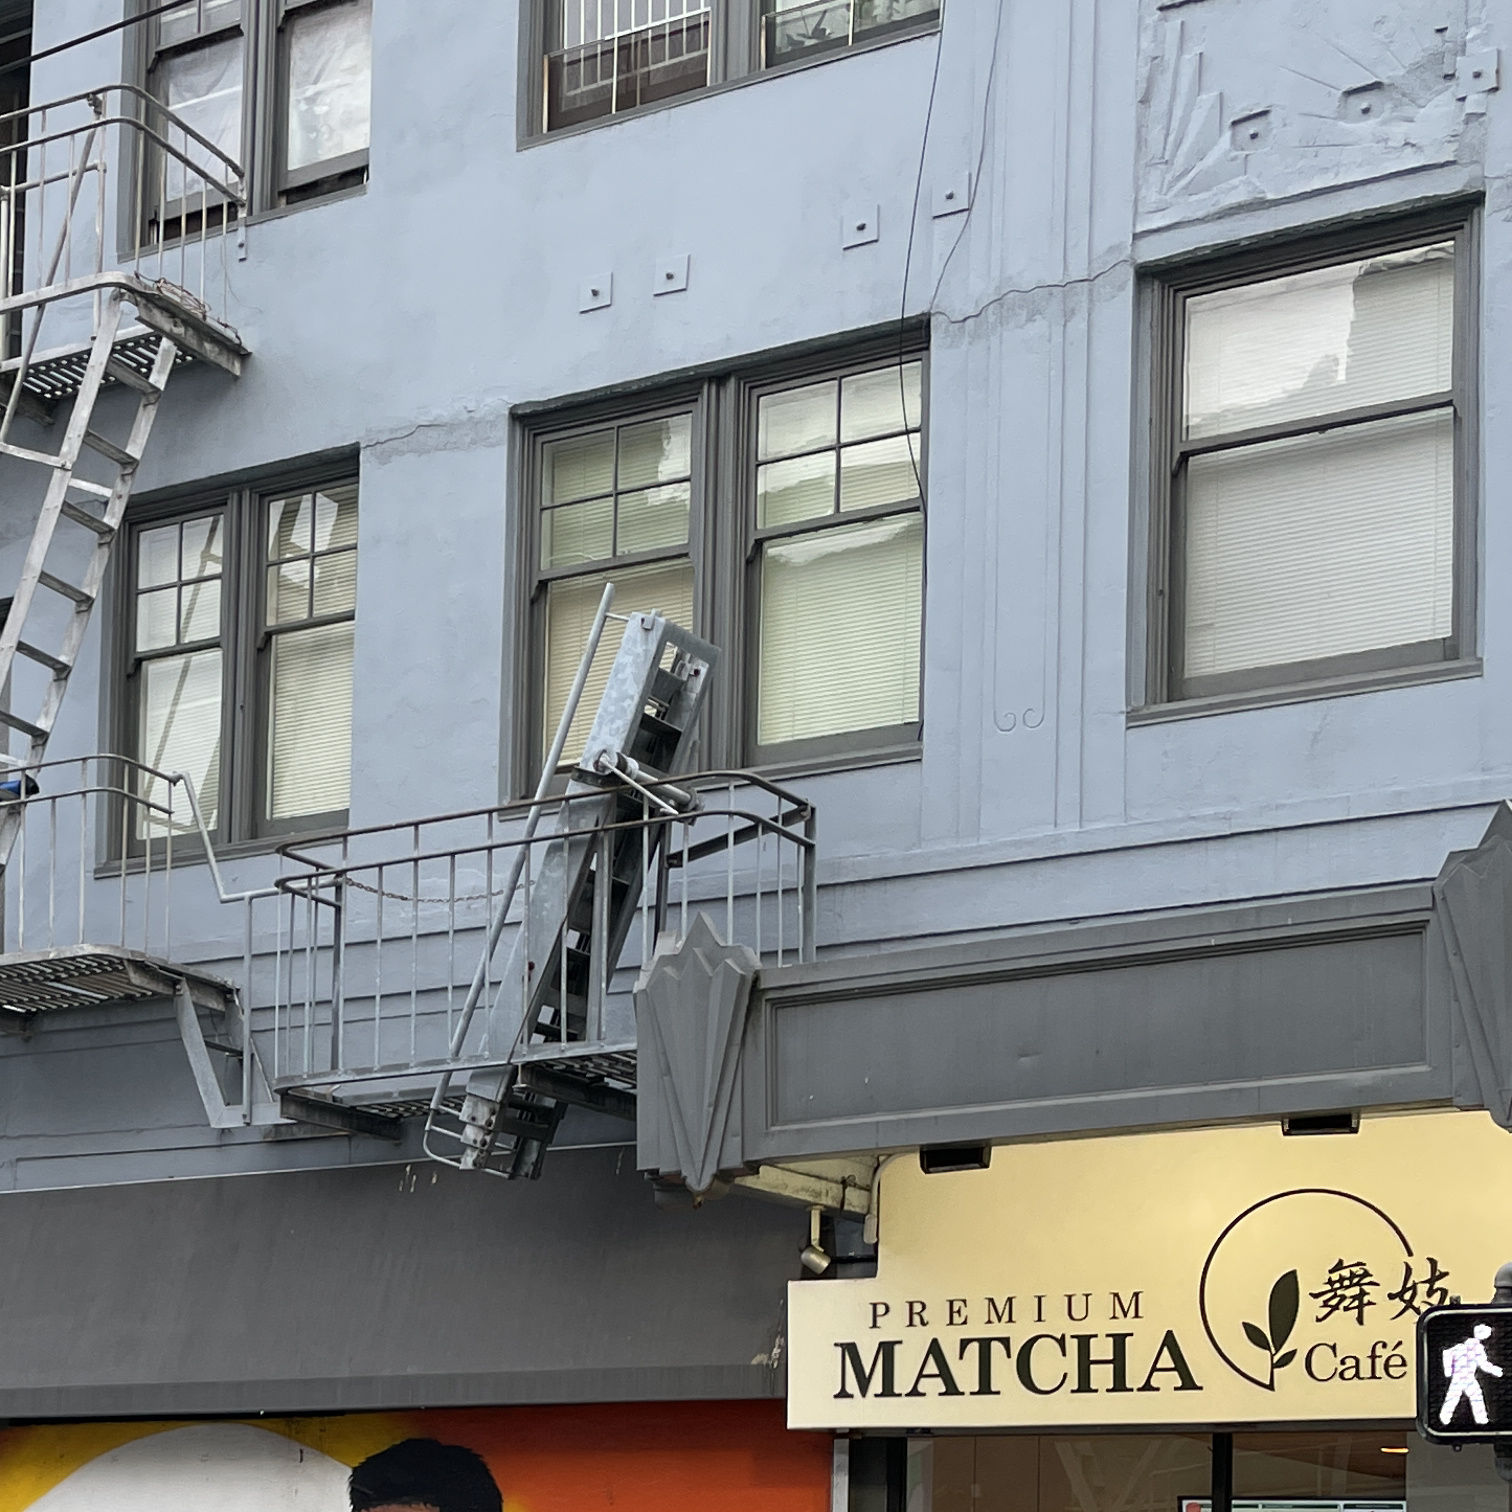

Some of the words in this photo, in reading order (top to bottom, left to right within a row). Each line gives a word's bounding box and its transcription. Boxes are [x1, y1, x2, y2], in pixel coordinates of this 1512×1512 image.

[868, 1290, 1145, 1329] PREMIUM
[833, 1329, 1204, 1400] MATCHA
[1304, 1340, 1408, 1382] Café
